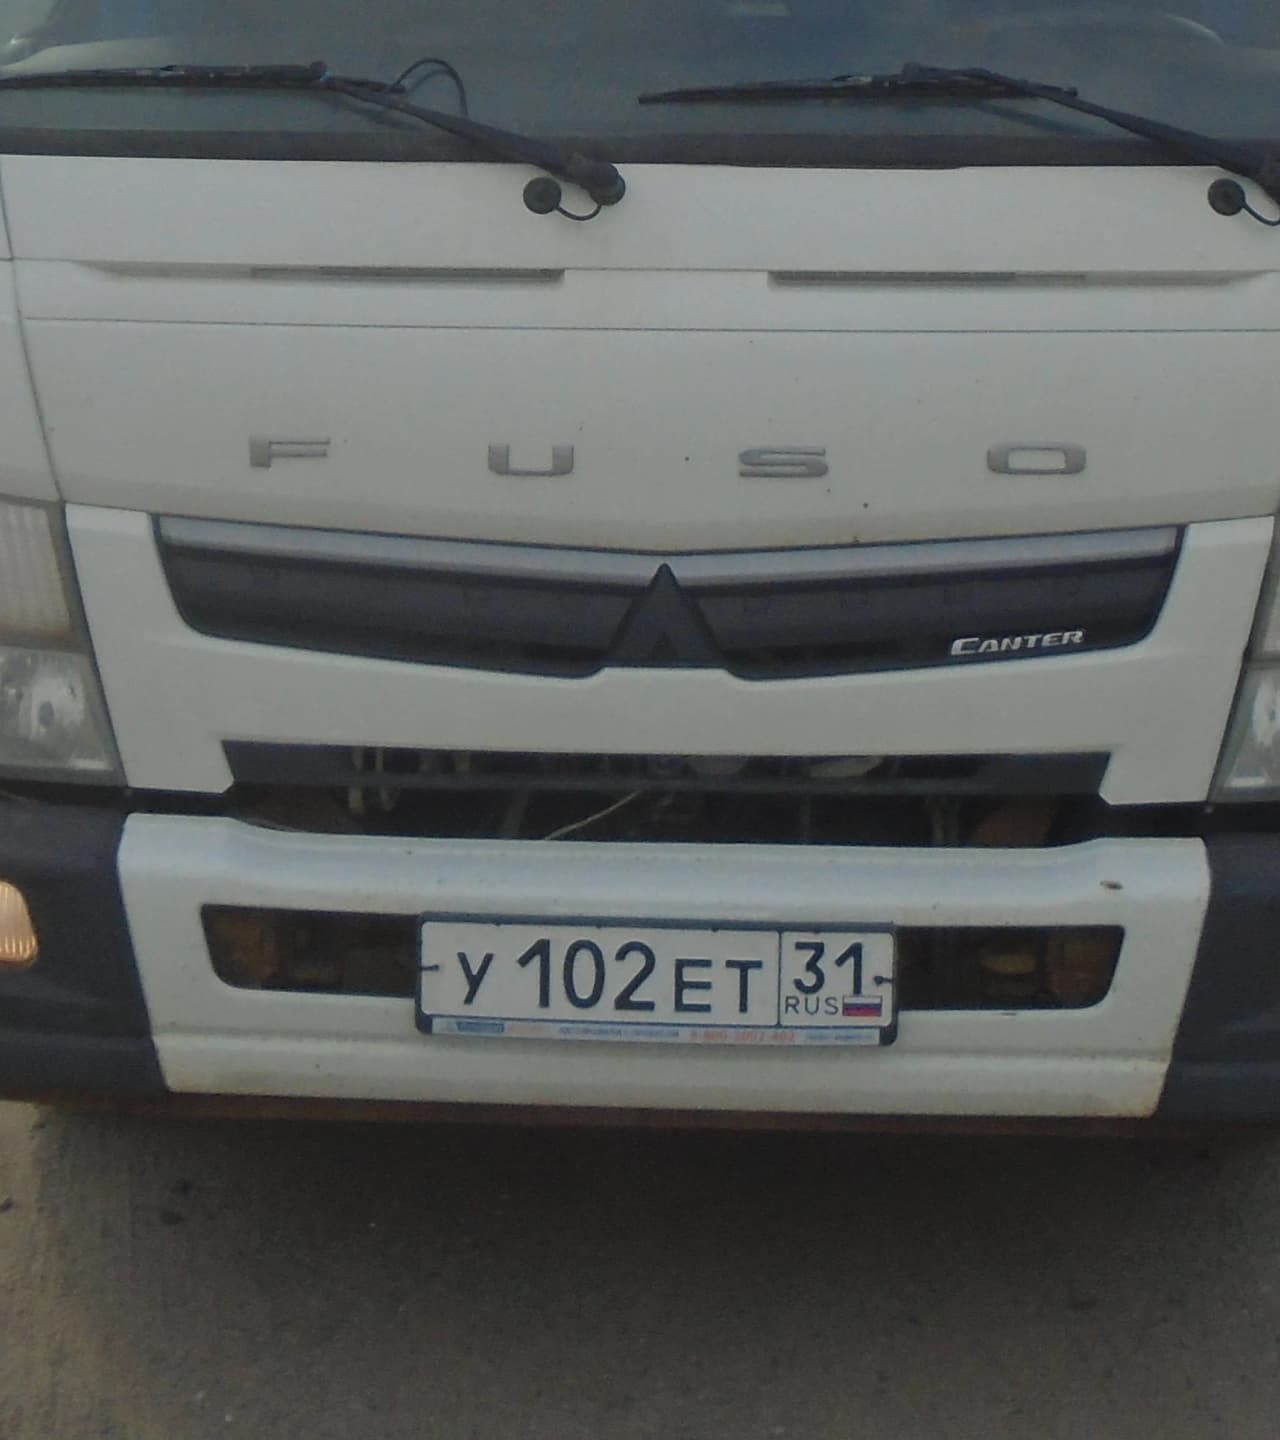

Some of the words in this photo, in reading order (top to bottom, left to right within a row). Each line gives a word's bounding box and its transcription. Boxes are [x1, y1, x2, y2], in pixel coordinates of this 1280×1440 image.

[248, 433, 1087, 480] FUSO
[793, 941, 865, 996] 31
[784, 995, 840, 1017] RUS
